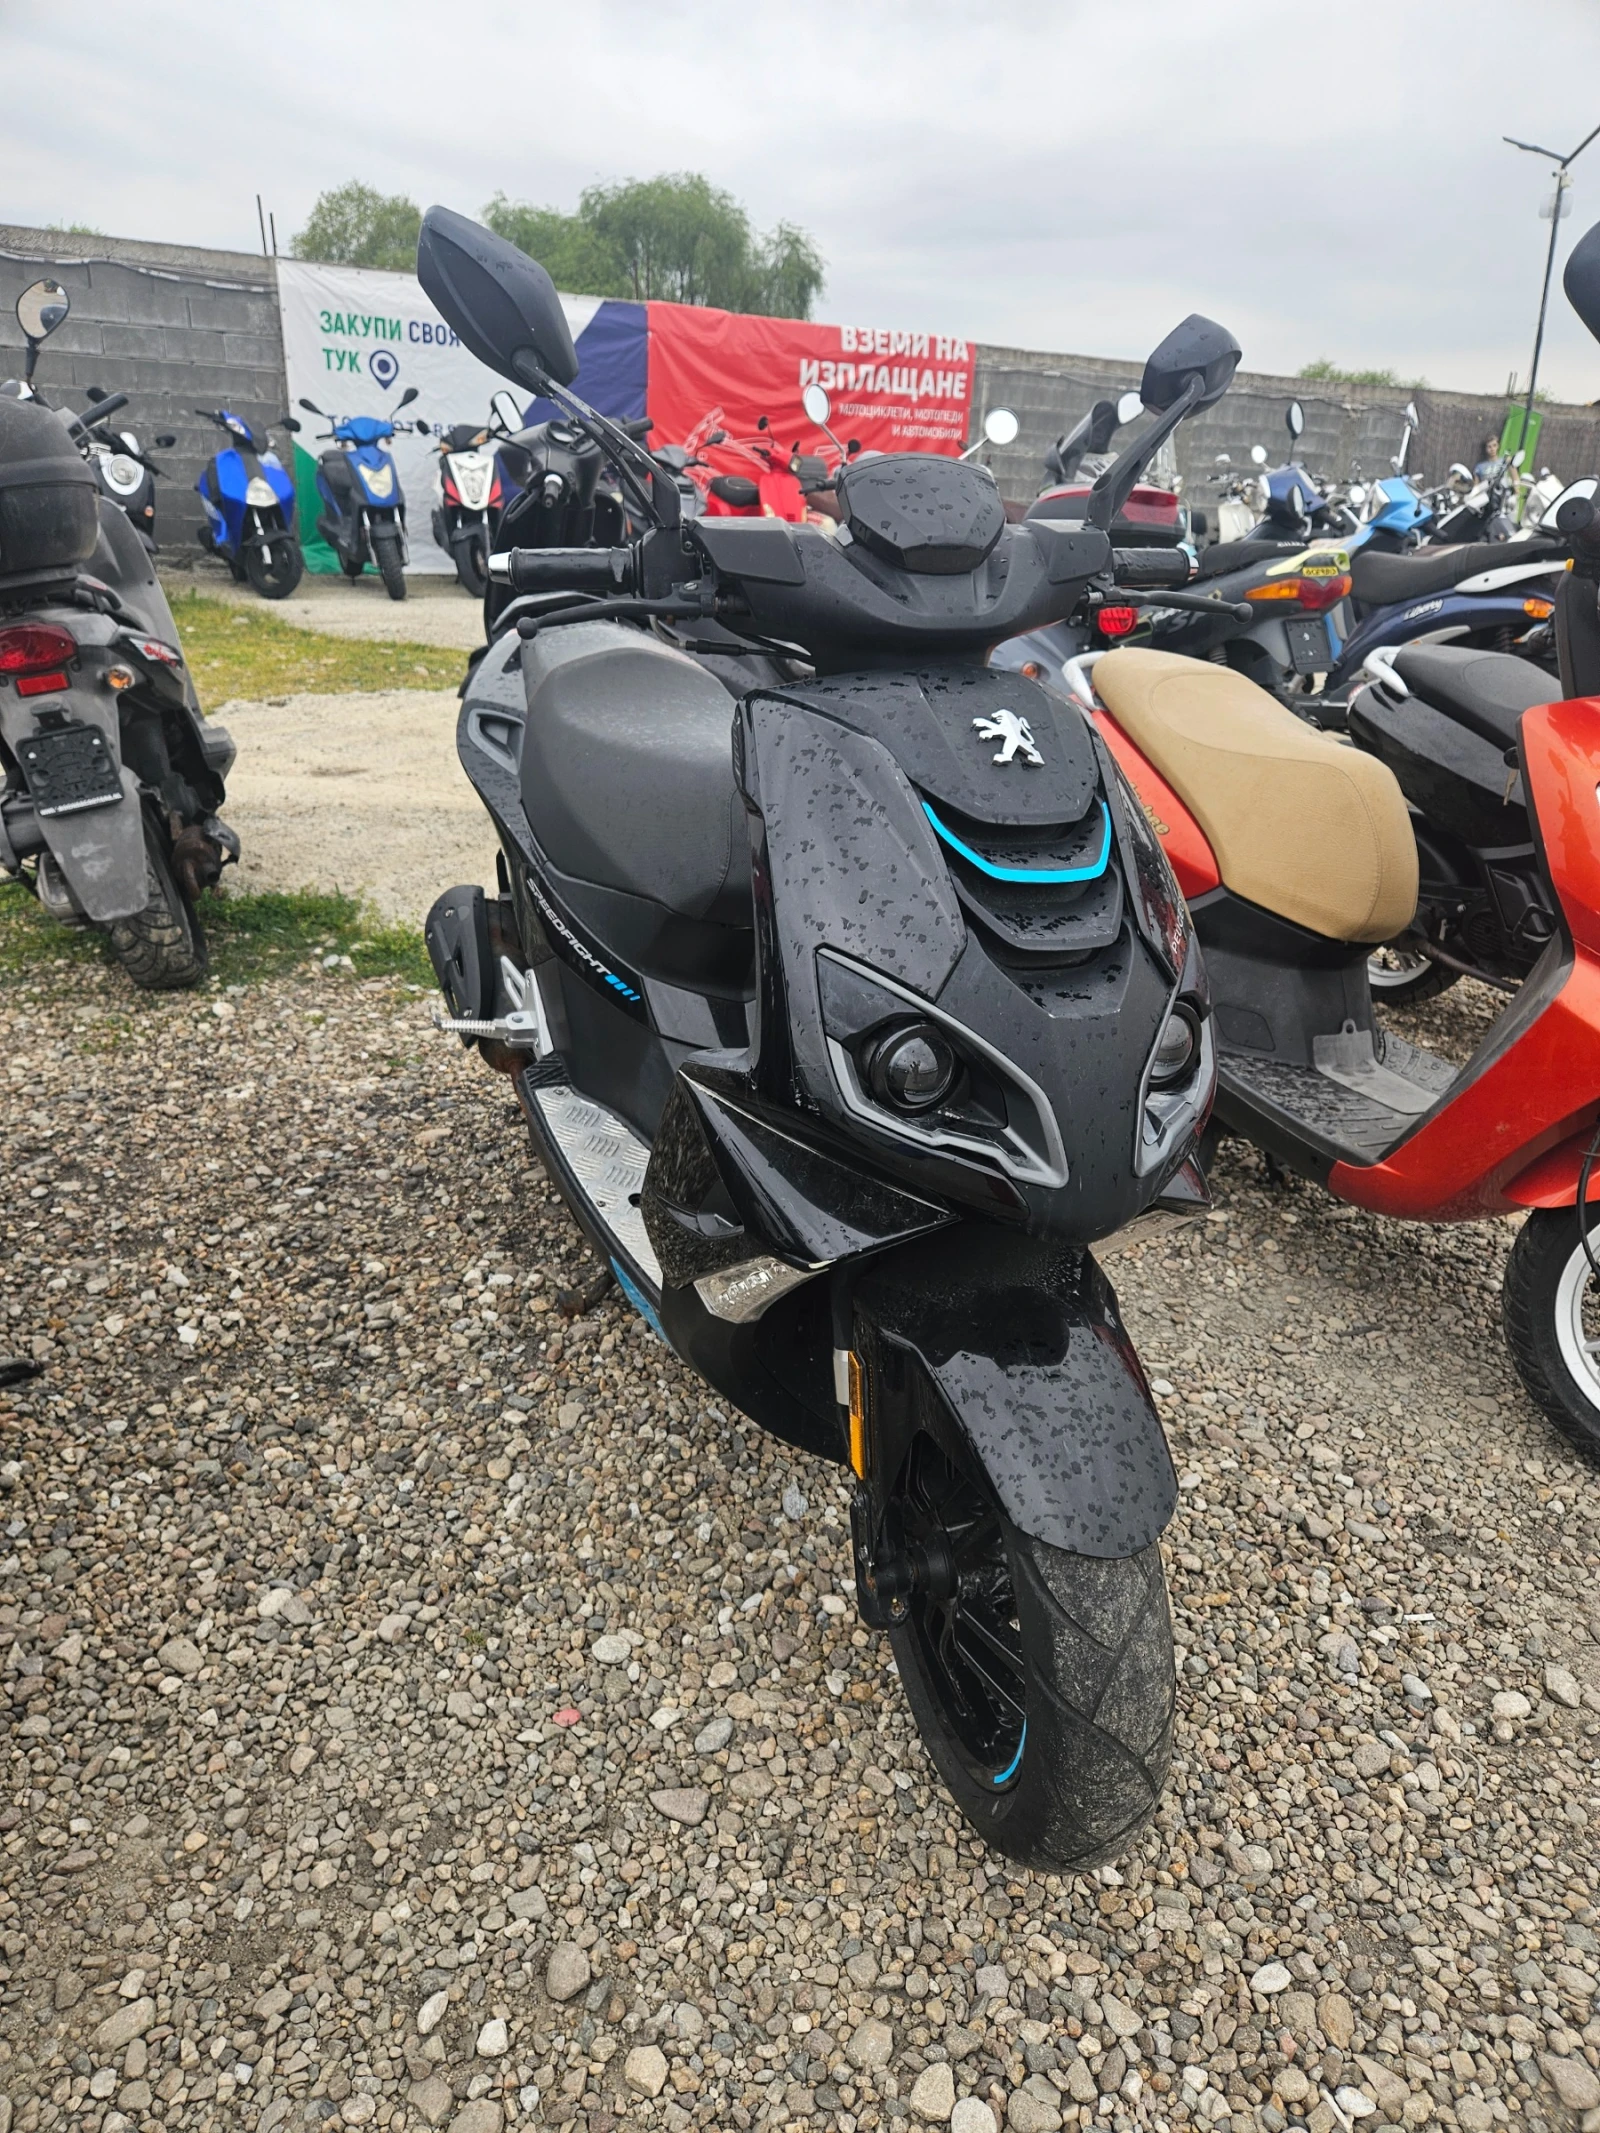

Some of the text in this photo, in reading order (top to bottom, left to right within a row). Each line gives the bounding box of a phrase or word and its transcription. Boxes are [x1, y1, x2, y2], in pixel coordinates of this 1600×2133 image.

[319, 310, 461, 348] ЗАКУПИ СВОЯ
[839, 325, 970, 362] ВЗЕМИ НА
[322, 347, 362, 374] ТУК
[798, 357, 968, 403] ИЗПЛАЩАНЕ
[838, 402, 964, 424] МОТОЦИКЛЕТИ, МОТОПЕДИ
[891, 425, 963, 440] И АВТОМОБИЛИ
[526, 877, 612, 976] SPEEDFIGHT
[1171, 900, 1185, 954] PEUGEO
